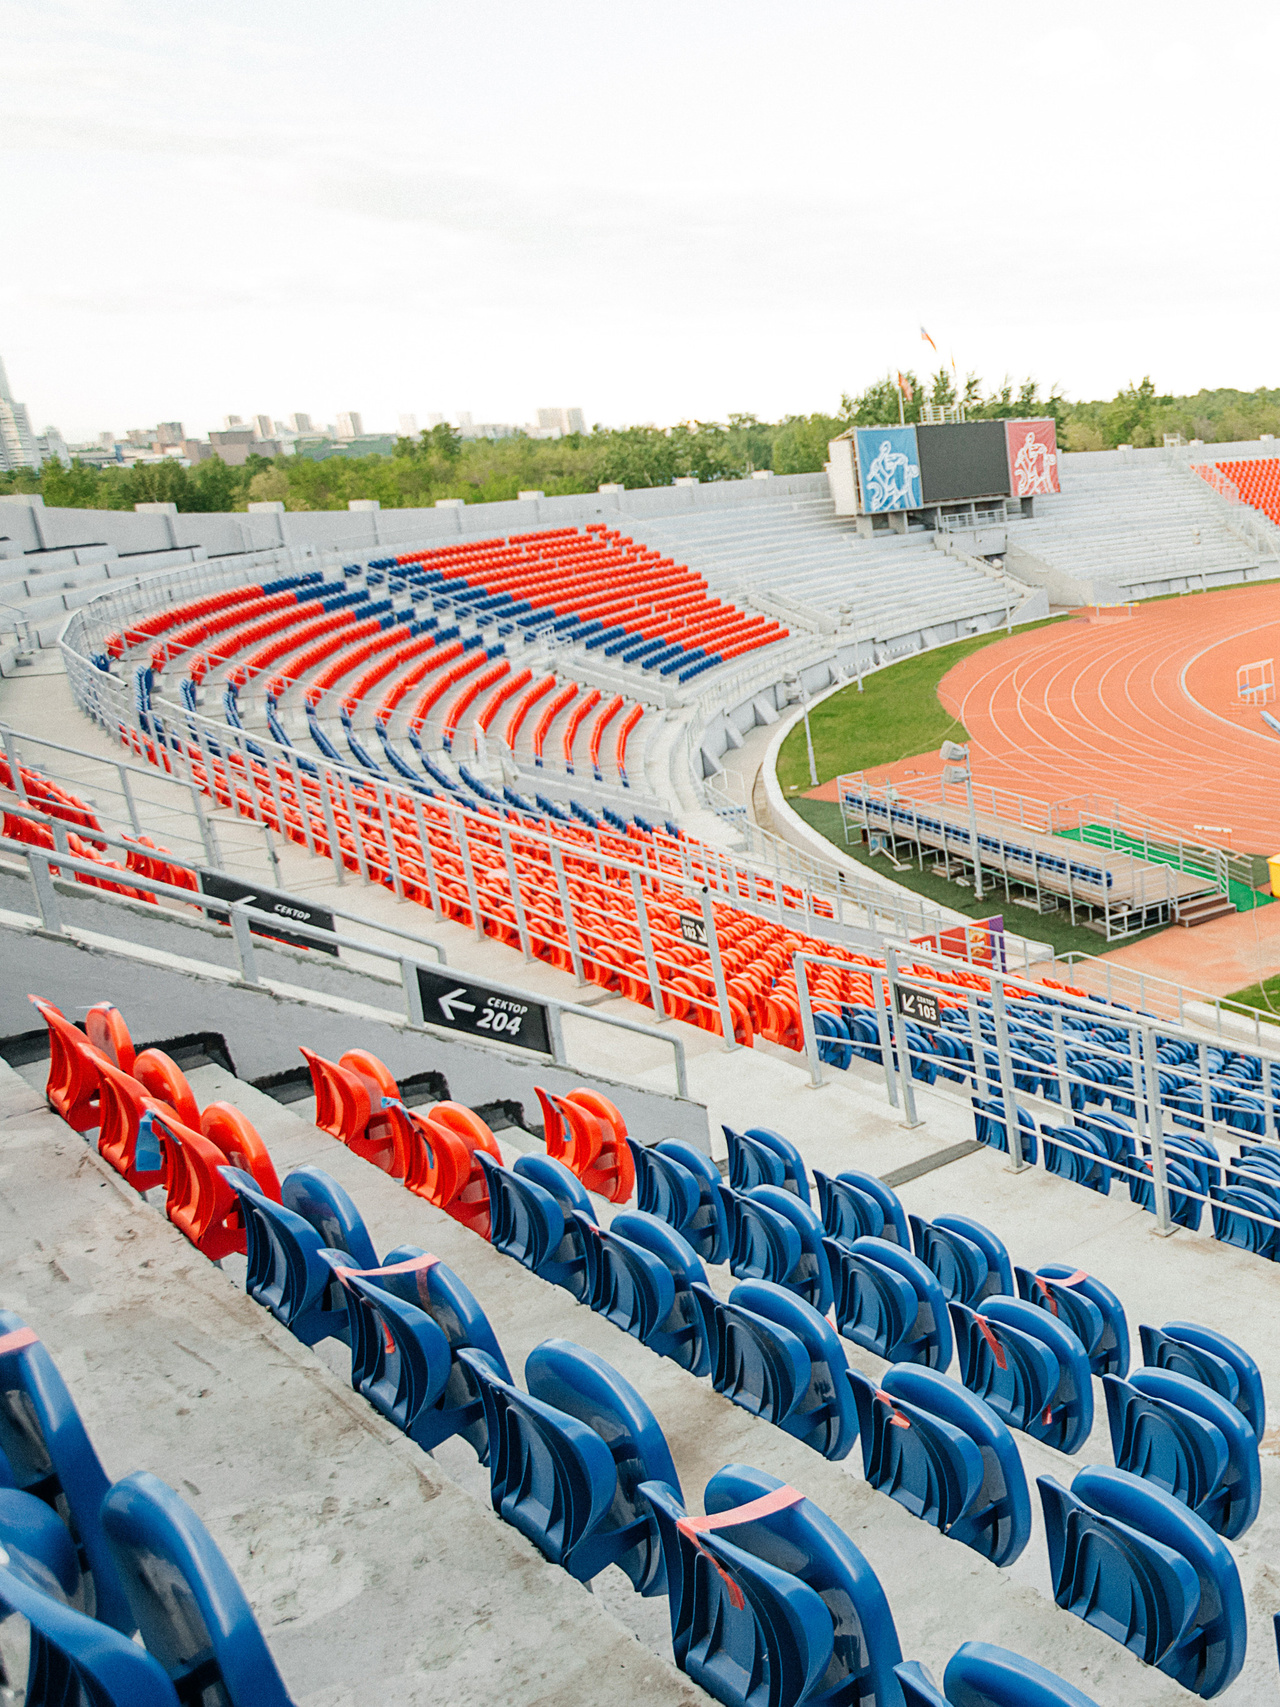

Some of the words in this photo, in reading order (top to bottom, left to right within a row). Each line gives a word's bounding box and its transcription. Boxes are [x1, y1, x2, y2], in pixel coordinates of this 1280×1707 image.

[274, 903, 310, 920] СЕКТОР
[683, 925, 697, 940] 102
[487, 996, 528, 1015] СЕКТОР
[918, 1003, 937, 1021] 103
[476, 1008, 522, 1036] 204
